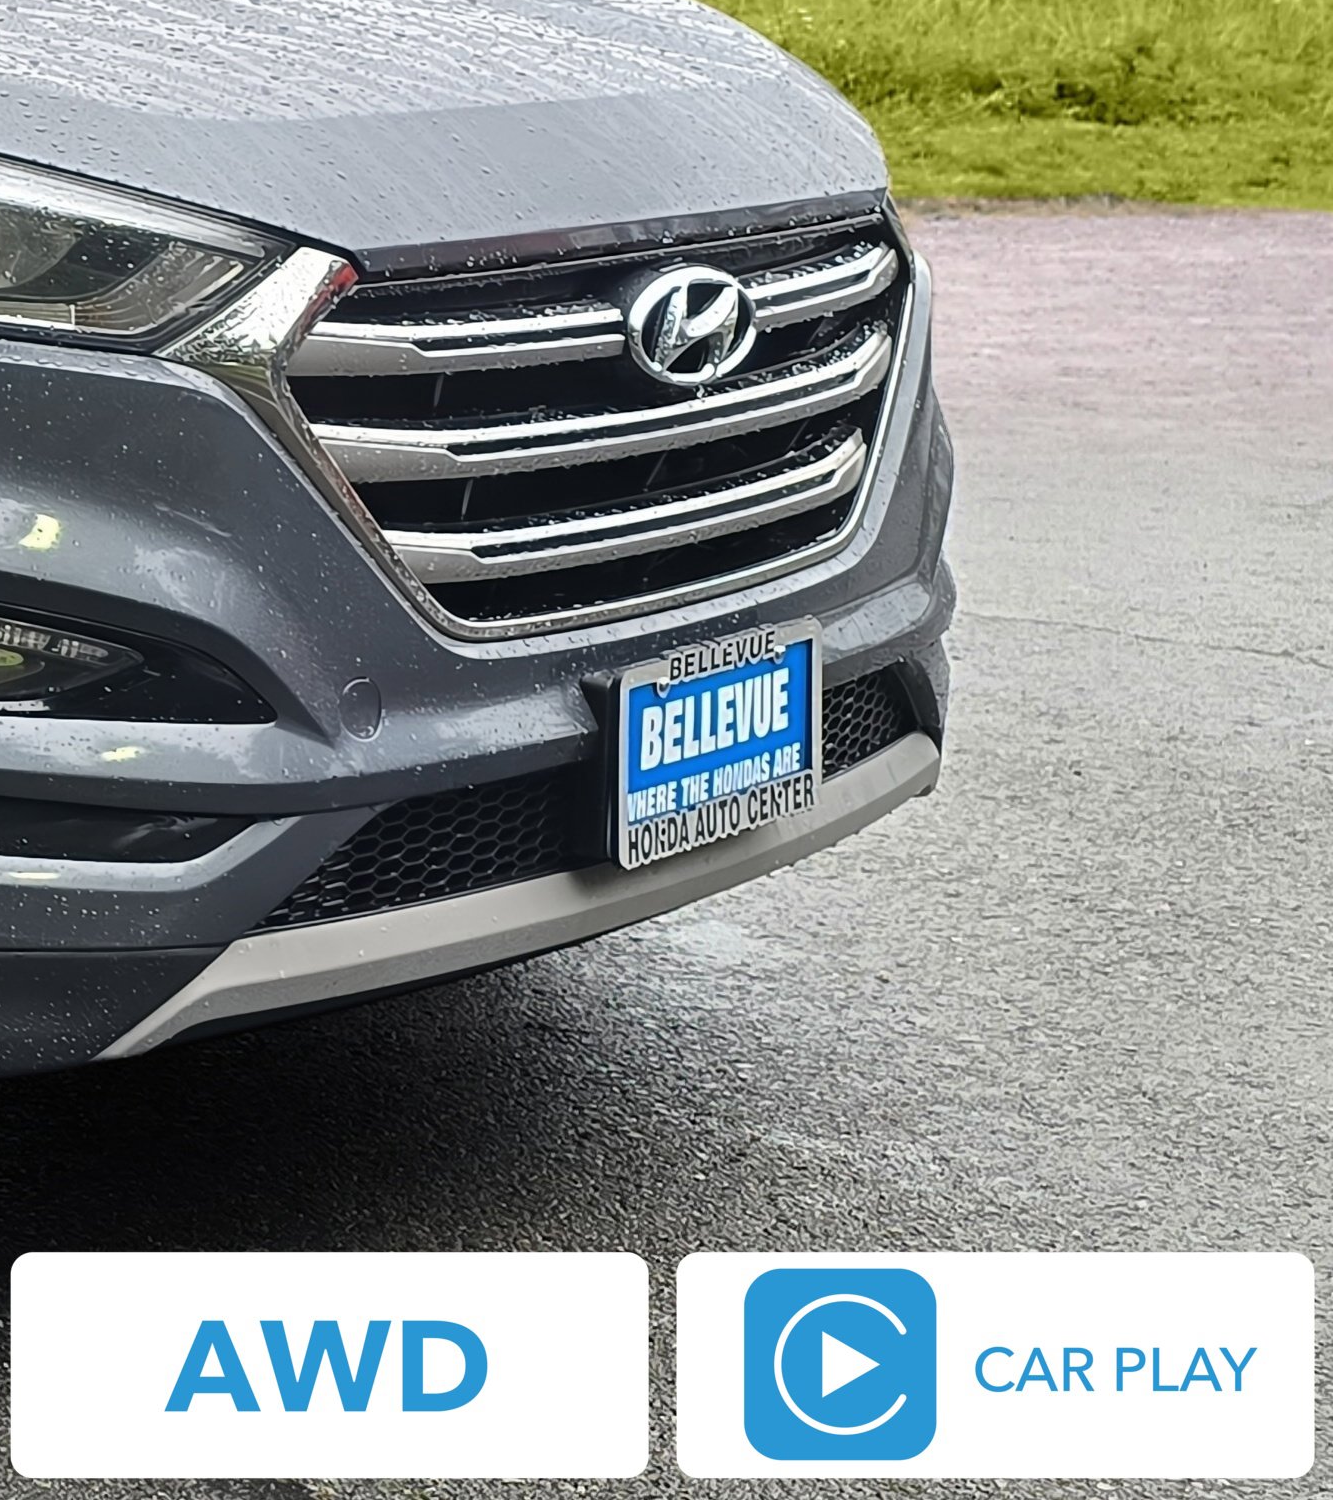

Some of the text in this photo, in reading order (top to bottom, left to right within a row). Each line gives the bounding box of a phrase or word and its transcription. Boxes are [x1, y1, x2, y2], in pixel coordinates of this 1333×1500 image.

[670, 630, 776, 681] BELLEVUE
[640, 667, 790, 771] BELLEVUE
[681, 772, 710, 807] THE
[713, 752, 771, 797] HONDAS
[773, 742, 801, 778] ARE
[628, 773, 815, 865] HONDA AUTO CENTER
